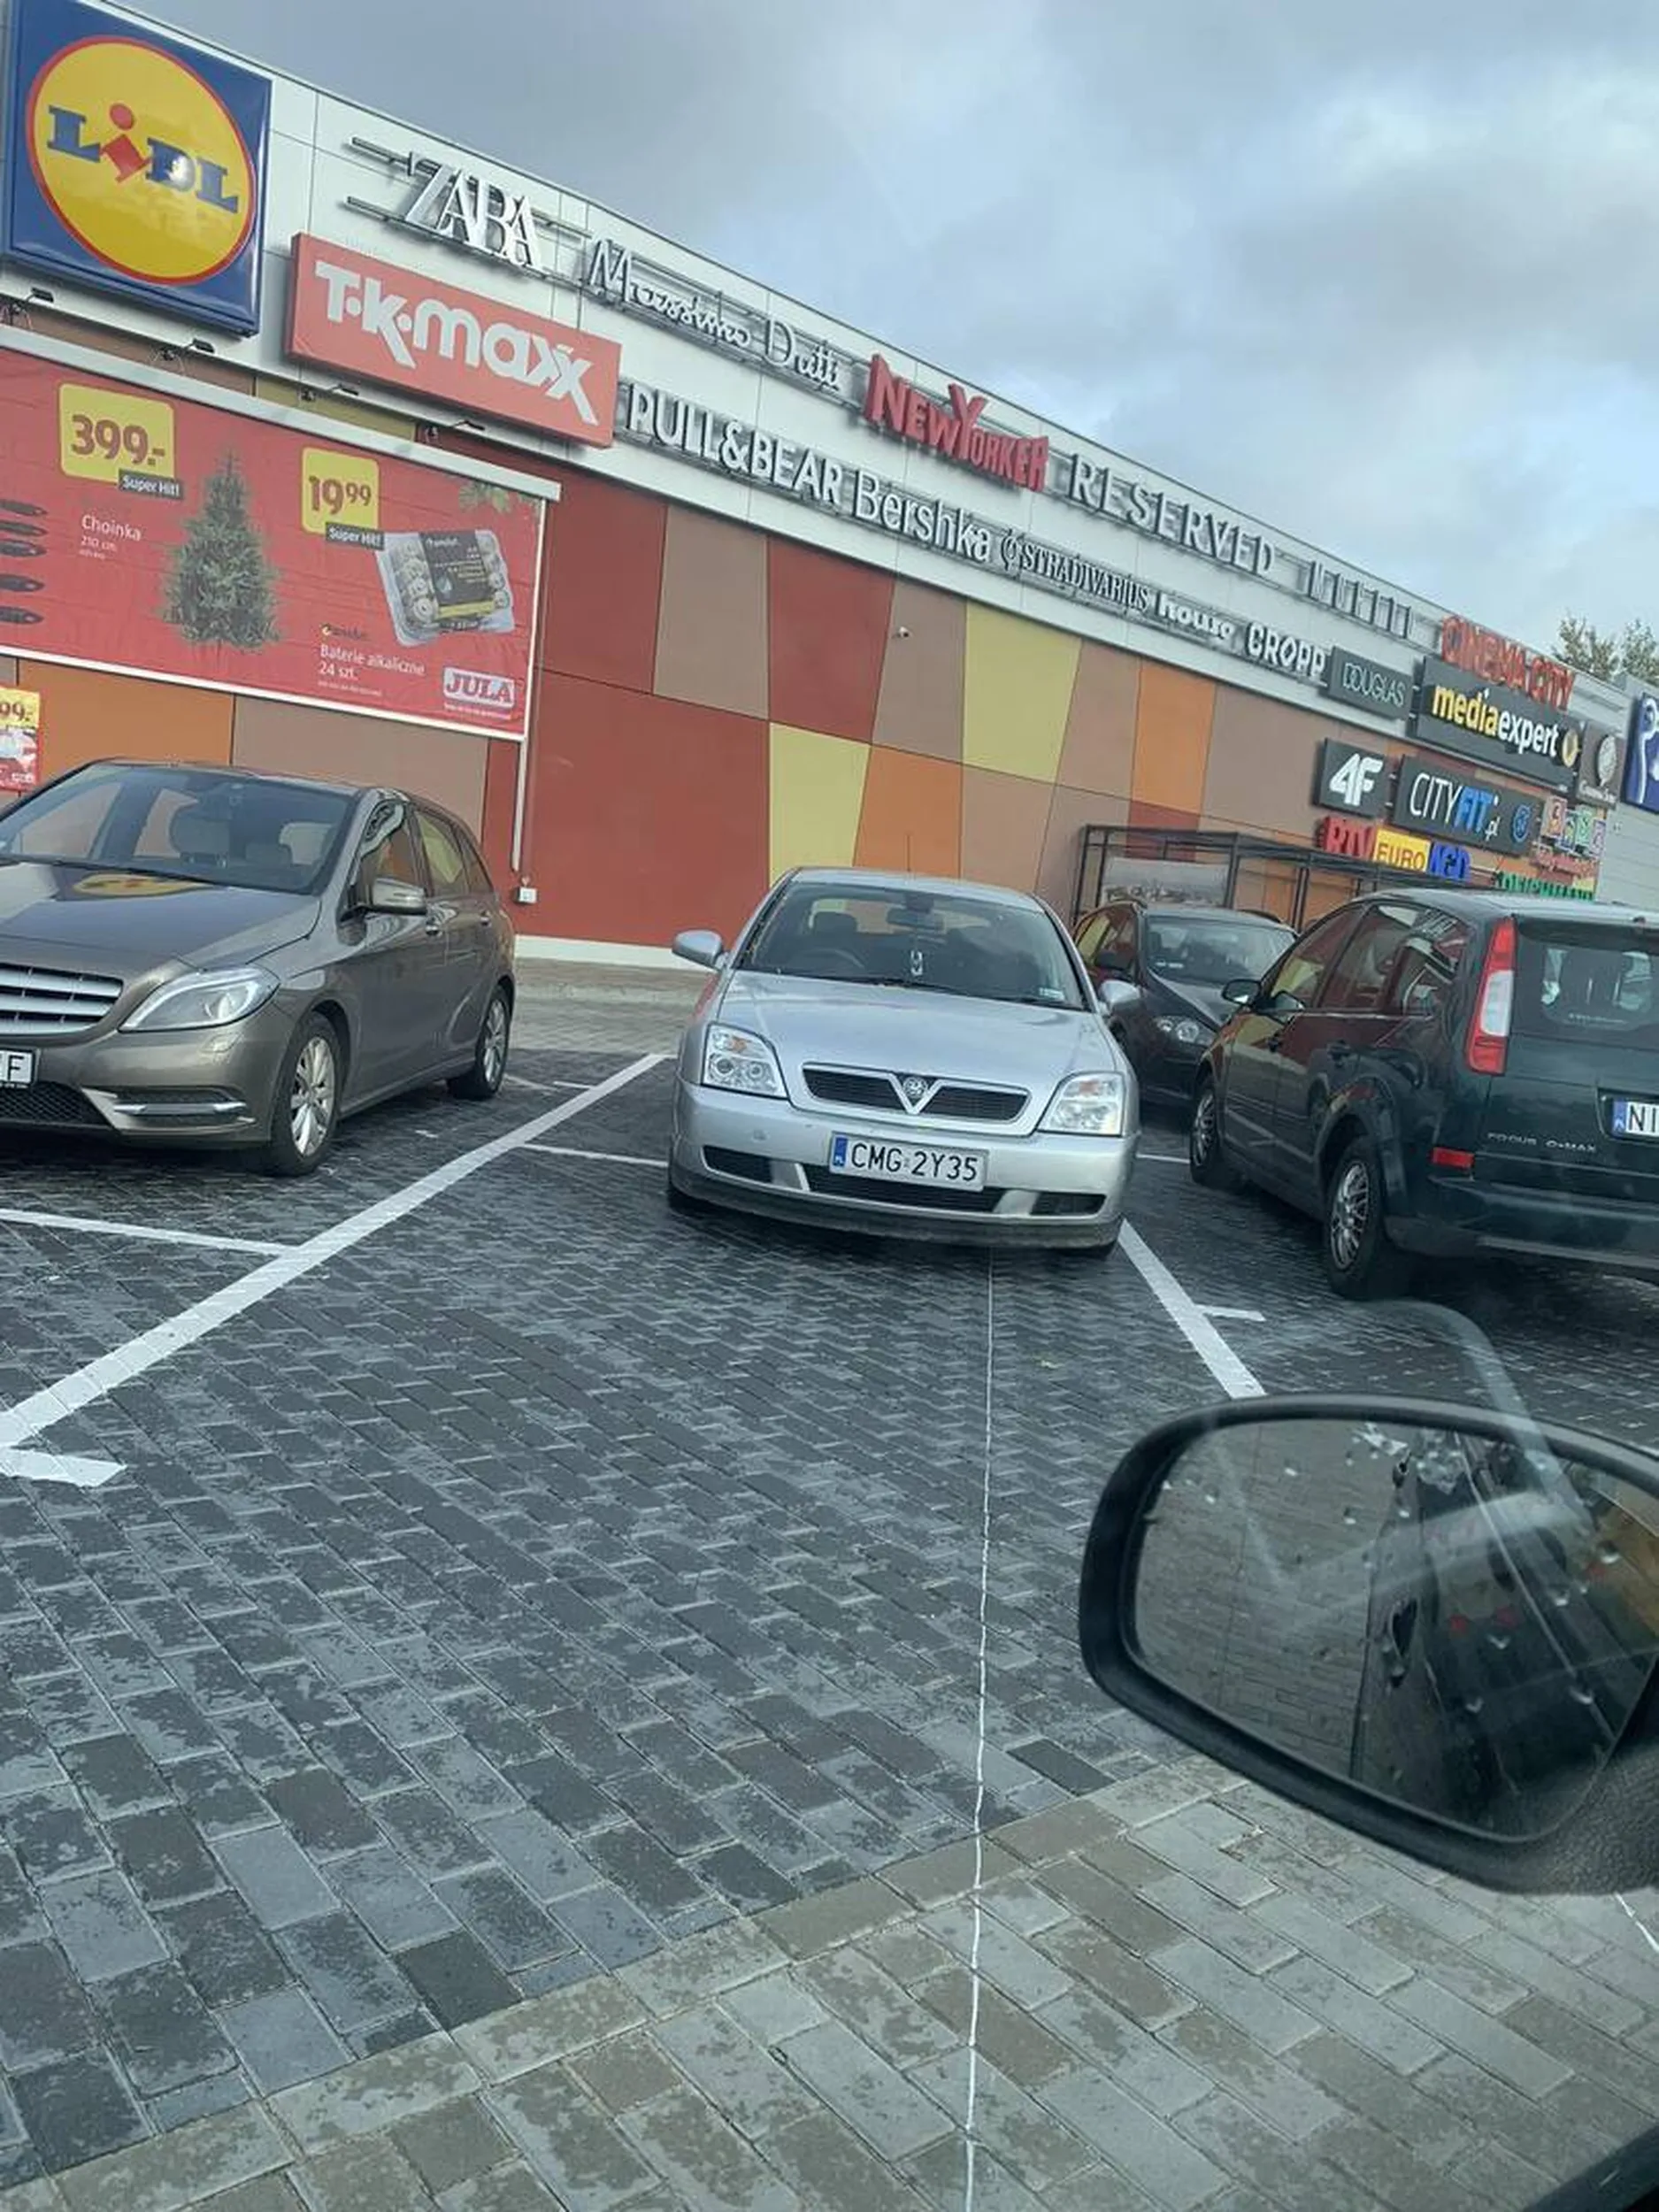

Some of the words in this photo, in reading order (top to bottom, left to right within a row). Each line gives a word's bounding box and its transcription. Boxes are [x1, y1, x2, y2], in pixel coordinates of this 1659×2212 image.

[404, 150, 542, 268] ZARA
[626, 382, 843, 506] PULL&BEAR
[123, 473, 157, 493] Super
[81, 513, 142, 542] Choinka
[328, 525, 359, 542] Super
[854, 469, 993, 564] Bershka
[1069, 452, 1276, 577] RESERVED
[1020, 541, 1151, 612] STRADIVARIUS
[1156, 590, 1237, 641] house
[319, 643, 365, 666] Baterie
[366, 654, 426, 678] alkaliczne
[319, 660, 336, 677] 24
[1245, 620, 1327, 680] CROPP
[446, 672, 513, 704] JULA
[1342, 661, 1407, 708] DOUGLAS
[1329, 752, 1384, 807] 4F
[1323, 816, 1377, 860] RTV
[1375, 842, 1427, 872] EURO
[850, 1141, 902, 1173] CMG
[910, 1150, 978, 1182] 2Y35
[1486, 1132, 1538, 1147] FOCUS
